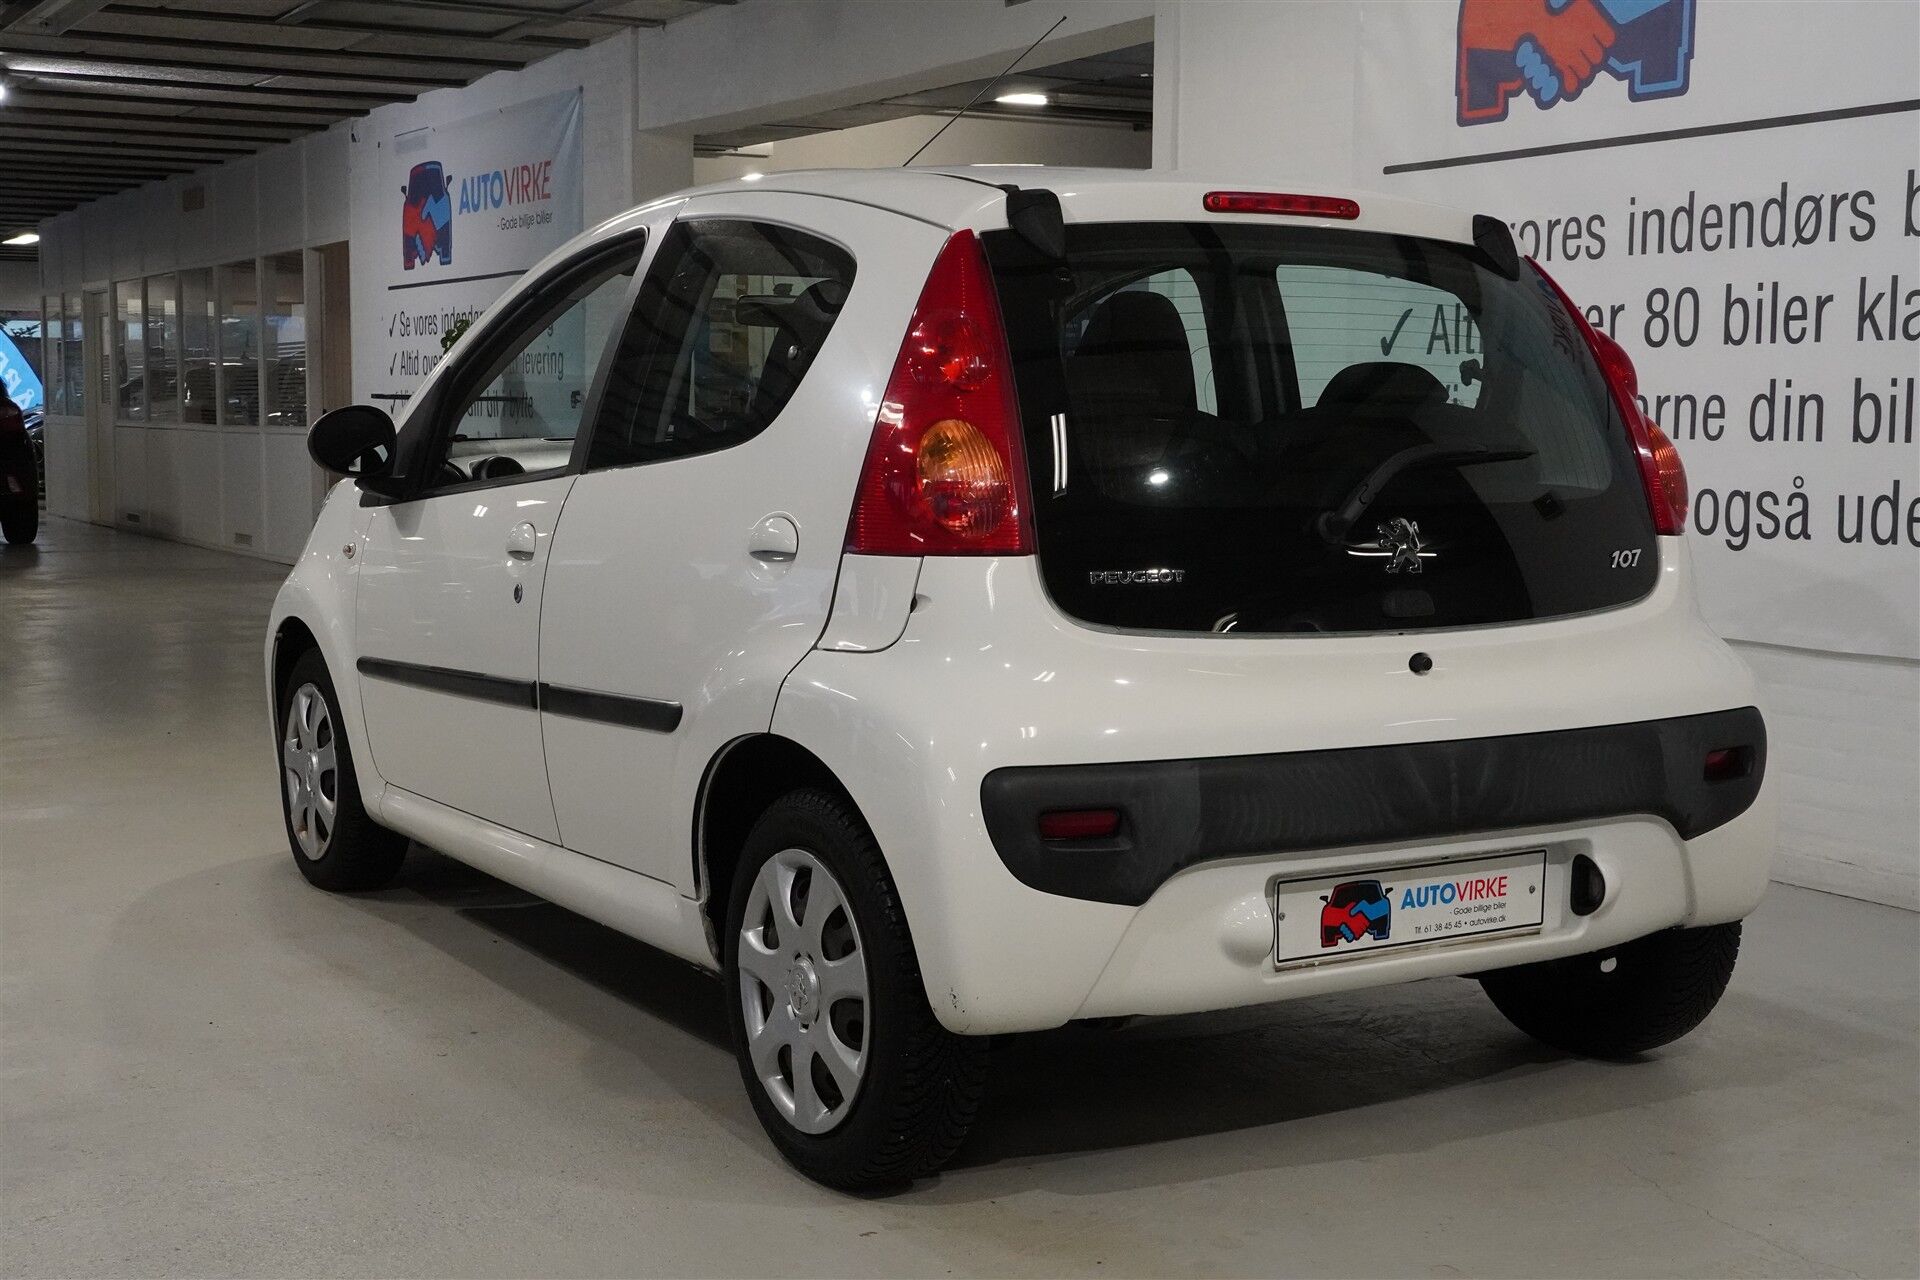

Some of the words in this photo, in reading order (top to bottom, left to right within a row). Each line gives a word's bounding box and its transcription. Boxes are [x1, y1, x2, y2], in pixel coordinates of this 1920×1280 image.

[459, 160, 552, 215] AUTOVIRKE
[501, 216, 518, 230] Gode
[1510, 214, 1606, 261] ores
[1628, 181, 1876, 257] indendørs
[400, 311, 411, 337] Se
[413, 314, 438, 336] vores
[1426, 303, 1484, 354] Alt
[1644, 286, 1700, 348] 80
[1723, 281, 1834, 346] biler
[400, 350, 419, 376] Altid
[522, 346, 564, 380] levering
[1750, 378, 1824, 442] din
[1852, 377, 1915, 443] bil
[1694, 475, 1812, 551] også
[1612, 548, 1642, 568] 107
[1089, 568, 1185, 585] PEUGEOT
[1400, 876, 1508, 910] AUTOVIRKE
[1453, 906, 1472, 916] Gode
[1473, 903, 1492, 914] billige
[1493, 901, 1507, 910] biler
[1424, 924, 1432, 933] 61
[1434, 923, 1443, 932] 38
[1444, 921, 1453, 930] 45
[1454, 920, 1462, 929] 45
